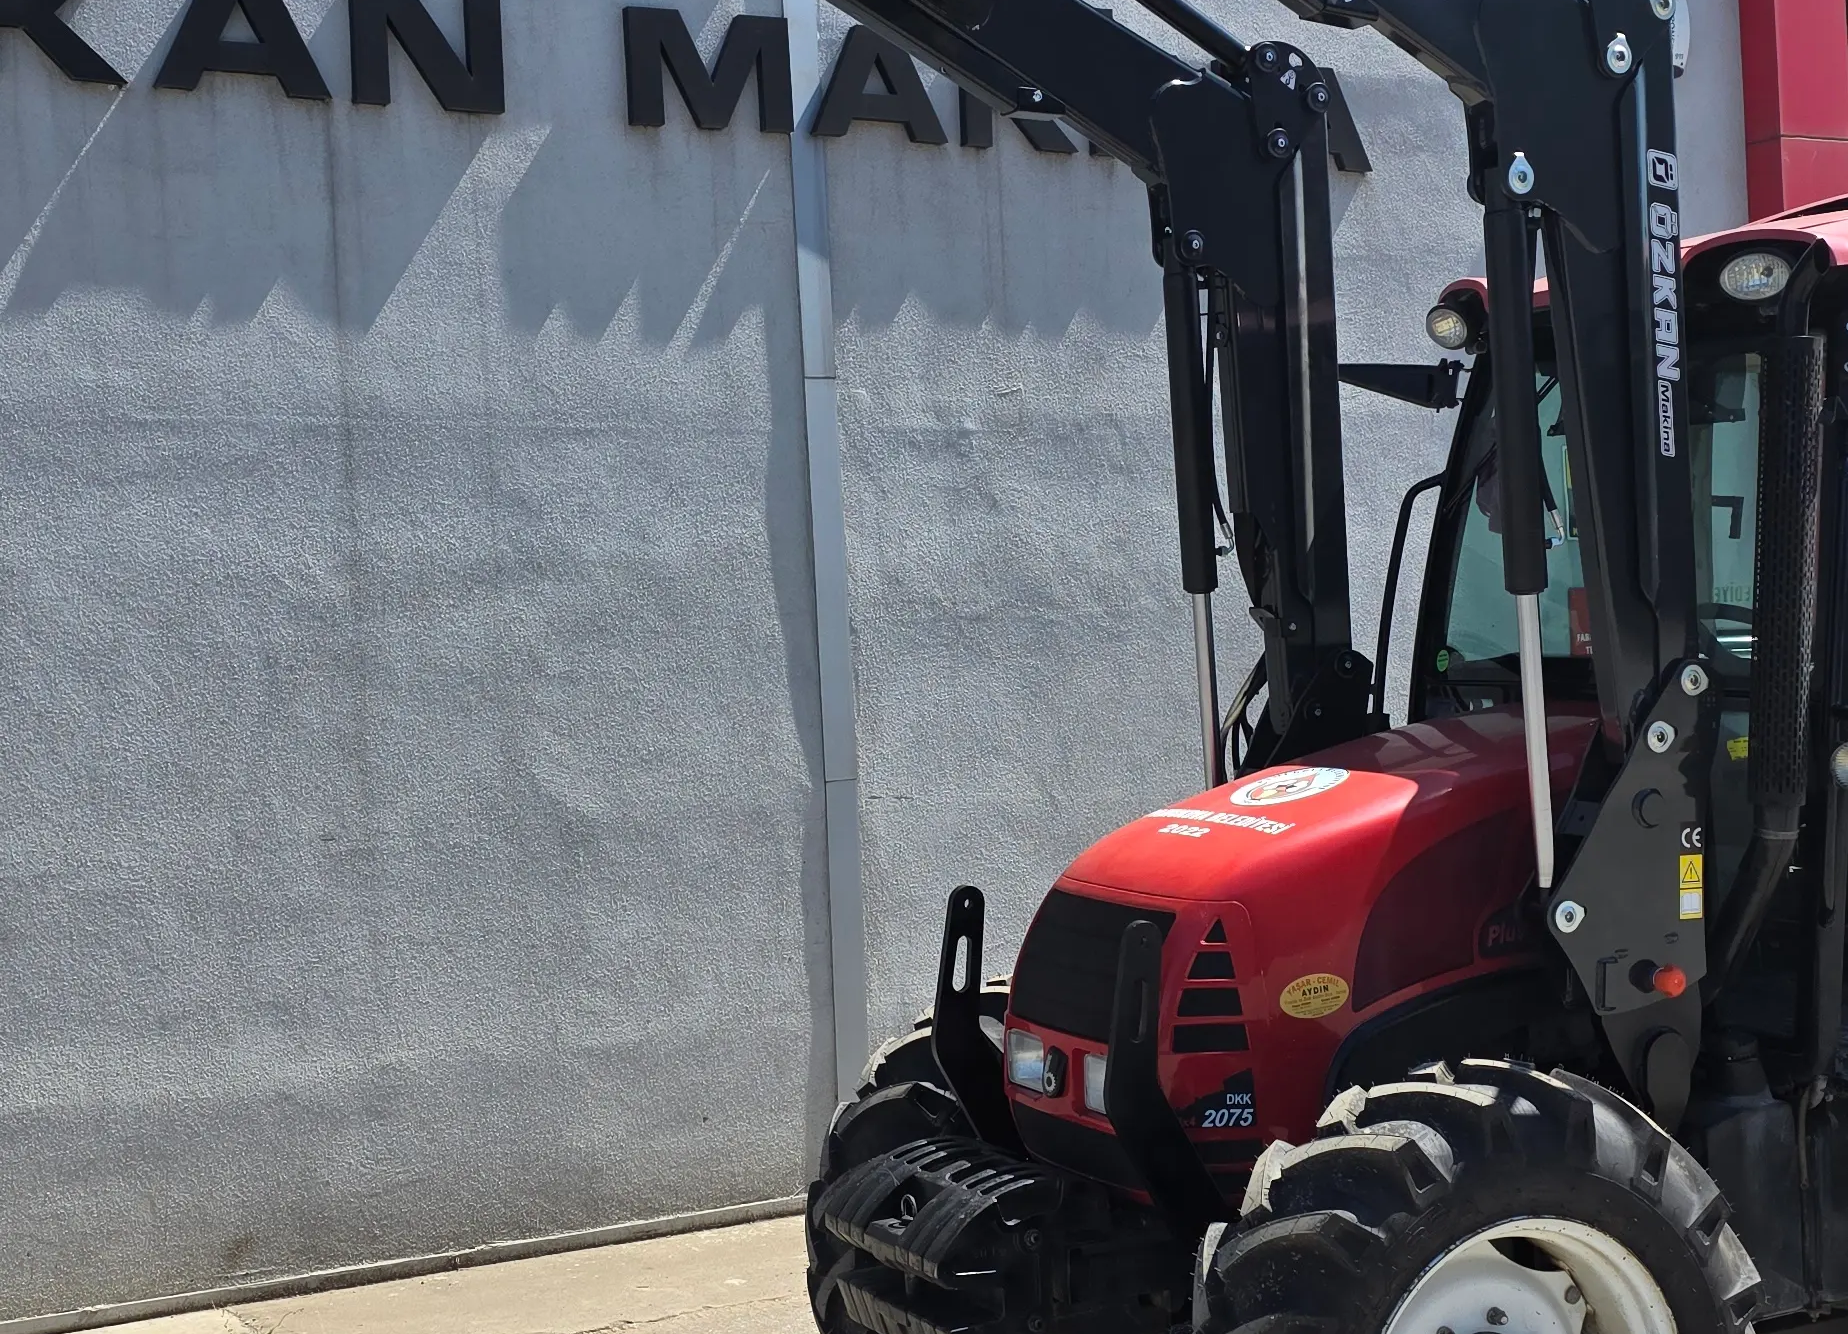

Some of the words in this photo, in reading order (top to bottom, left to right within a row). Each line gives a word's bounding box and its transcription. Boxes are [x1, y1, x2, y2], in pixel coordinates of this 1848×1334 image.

[1649, 202, 1681, 382] ÖZKAN
[1660, 384, 1673, 453] Makina
[1158, 824, 1211, 838] 2022
[1681, 827, 1702, 848] CE
[1301, 984, 1329, 997] AYDIN
[1226, 1093, 1252, 1105] DKK
[1202, 1108, 1254, 1128] 2075
